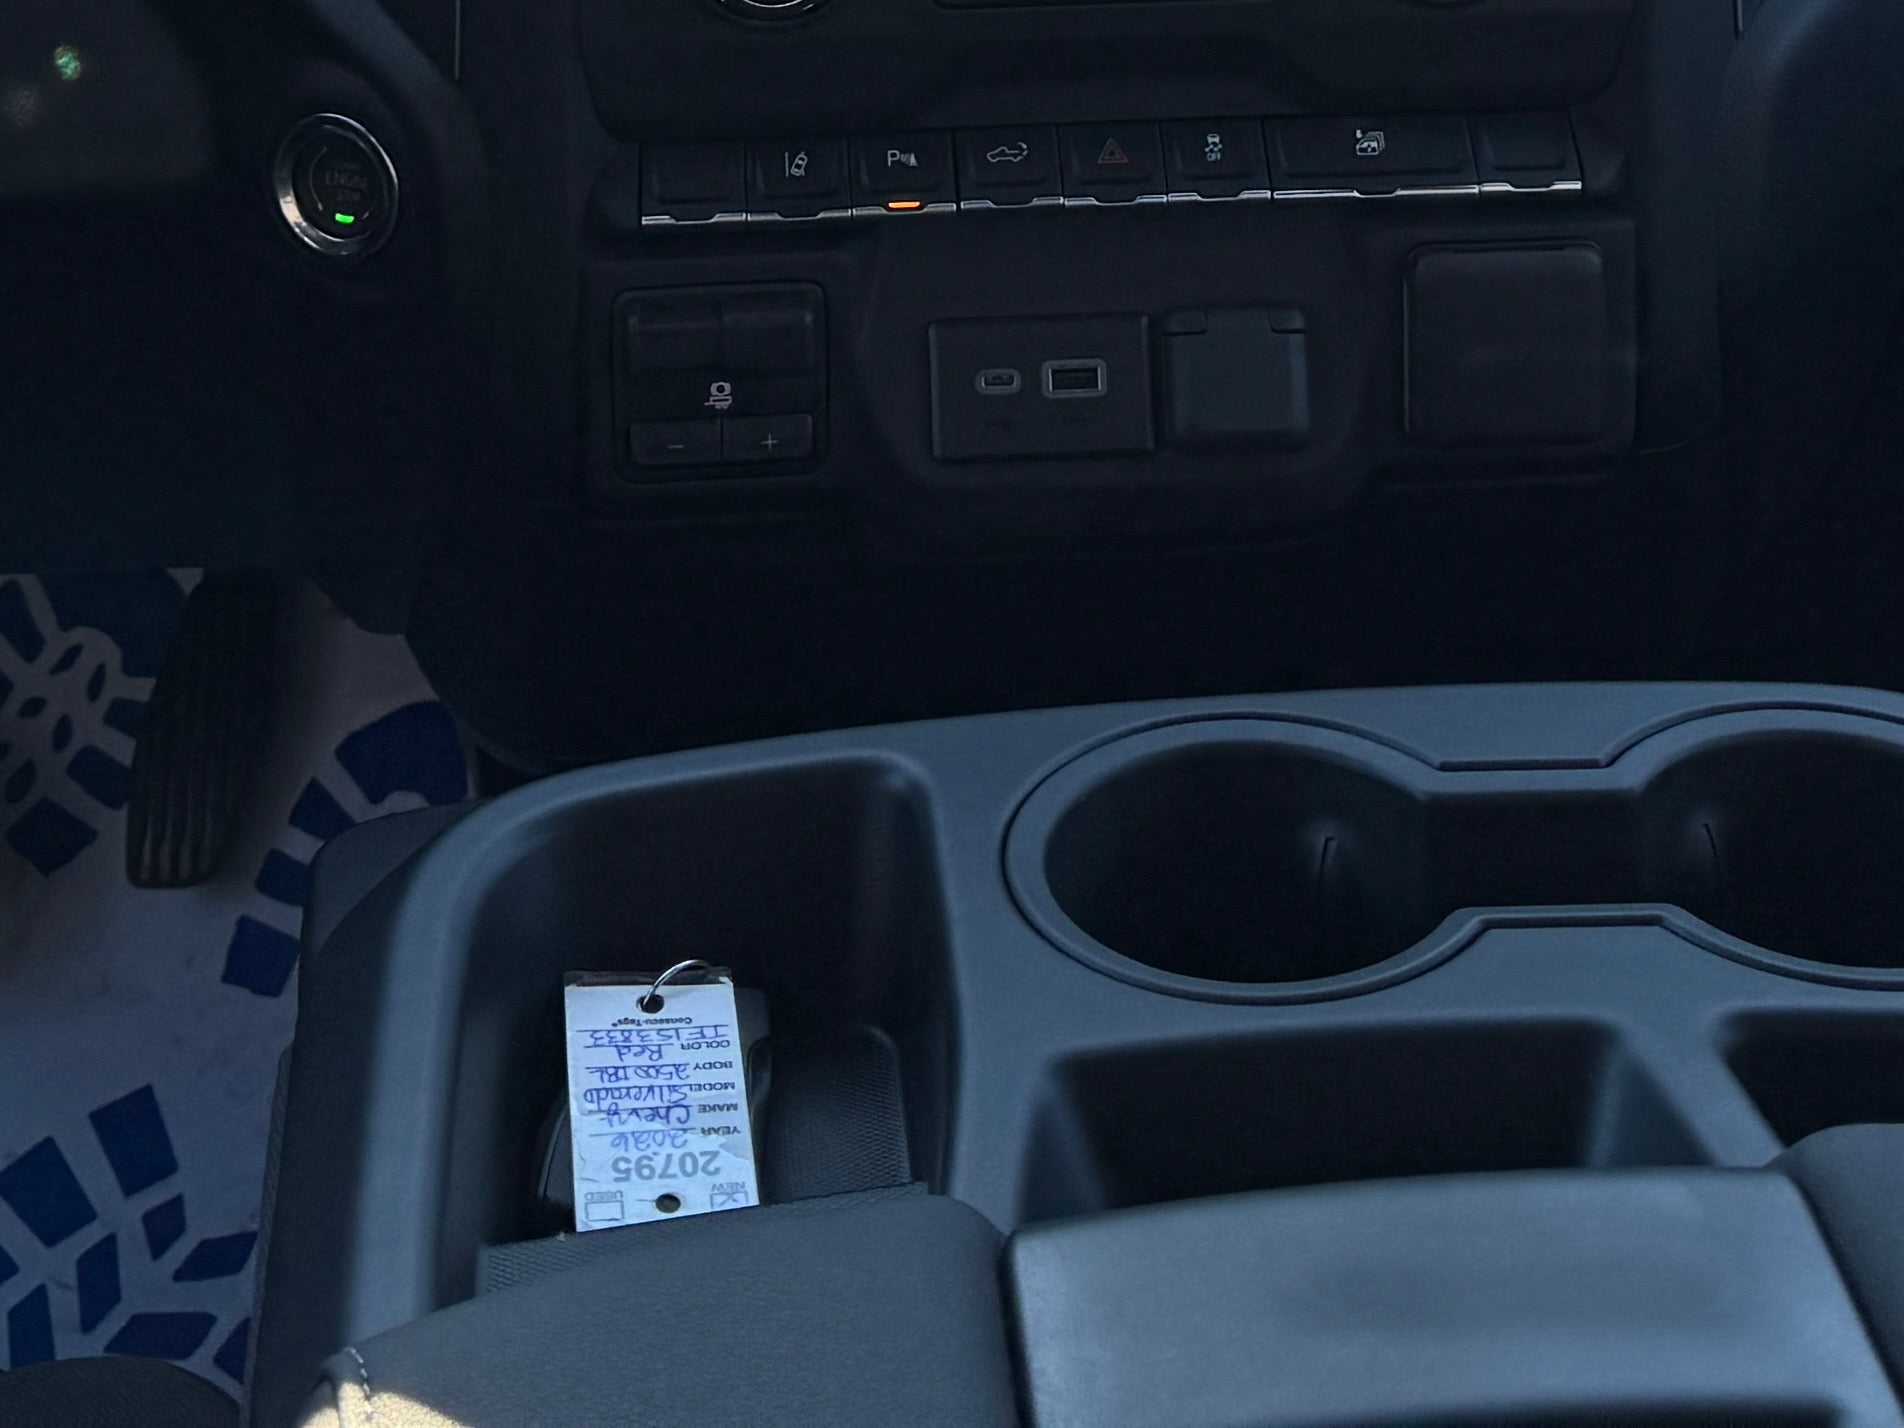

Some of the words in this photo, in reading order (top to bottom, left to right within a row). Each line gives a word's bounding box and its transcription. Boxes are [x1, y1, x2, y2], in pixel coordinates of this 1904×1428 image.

[680, 1040, 731, 1051] COLOR
[615, 1044, 664, 1062] Red
[693, 1060, 734, 1072] BODY
[689, 1081, 736, 1092] MODEL
[582, 1085, 688, 1108] Silverado
[697, 1103, 739, 1114] MAKE
[598, 1103, 691, 1128] Chevy
[699, 1126, 741, 1136] YEAR
[610, 1129, 689, 1152] 2026
[610, 1149, 722, 1183] 20795
[710, 1181, 747, 1193] NEW
